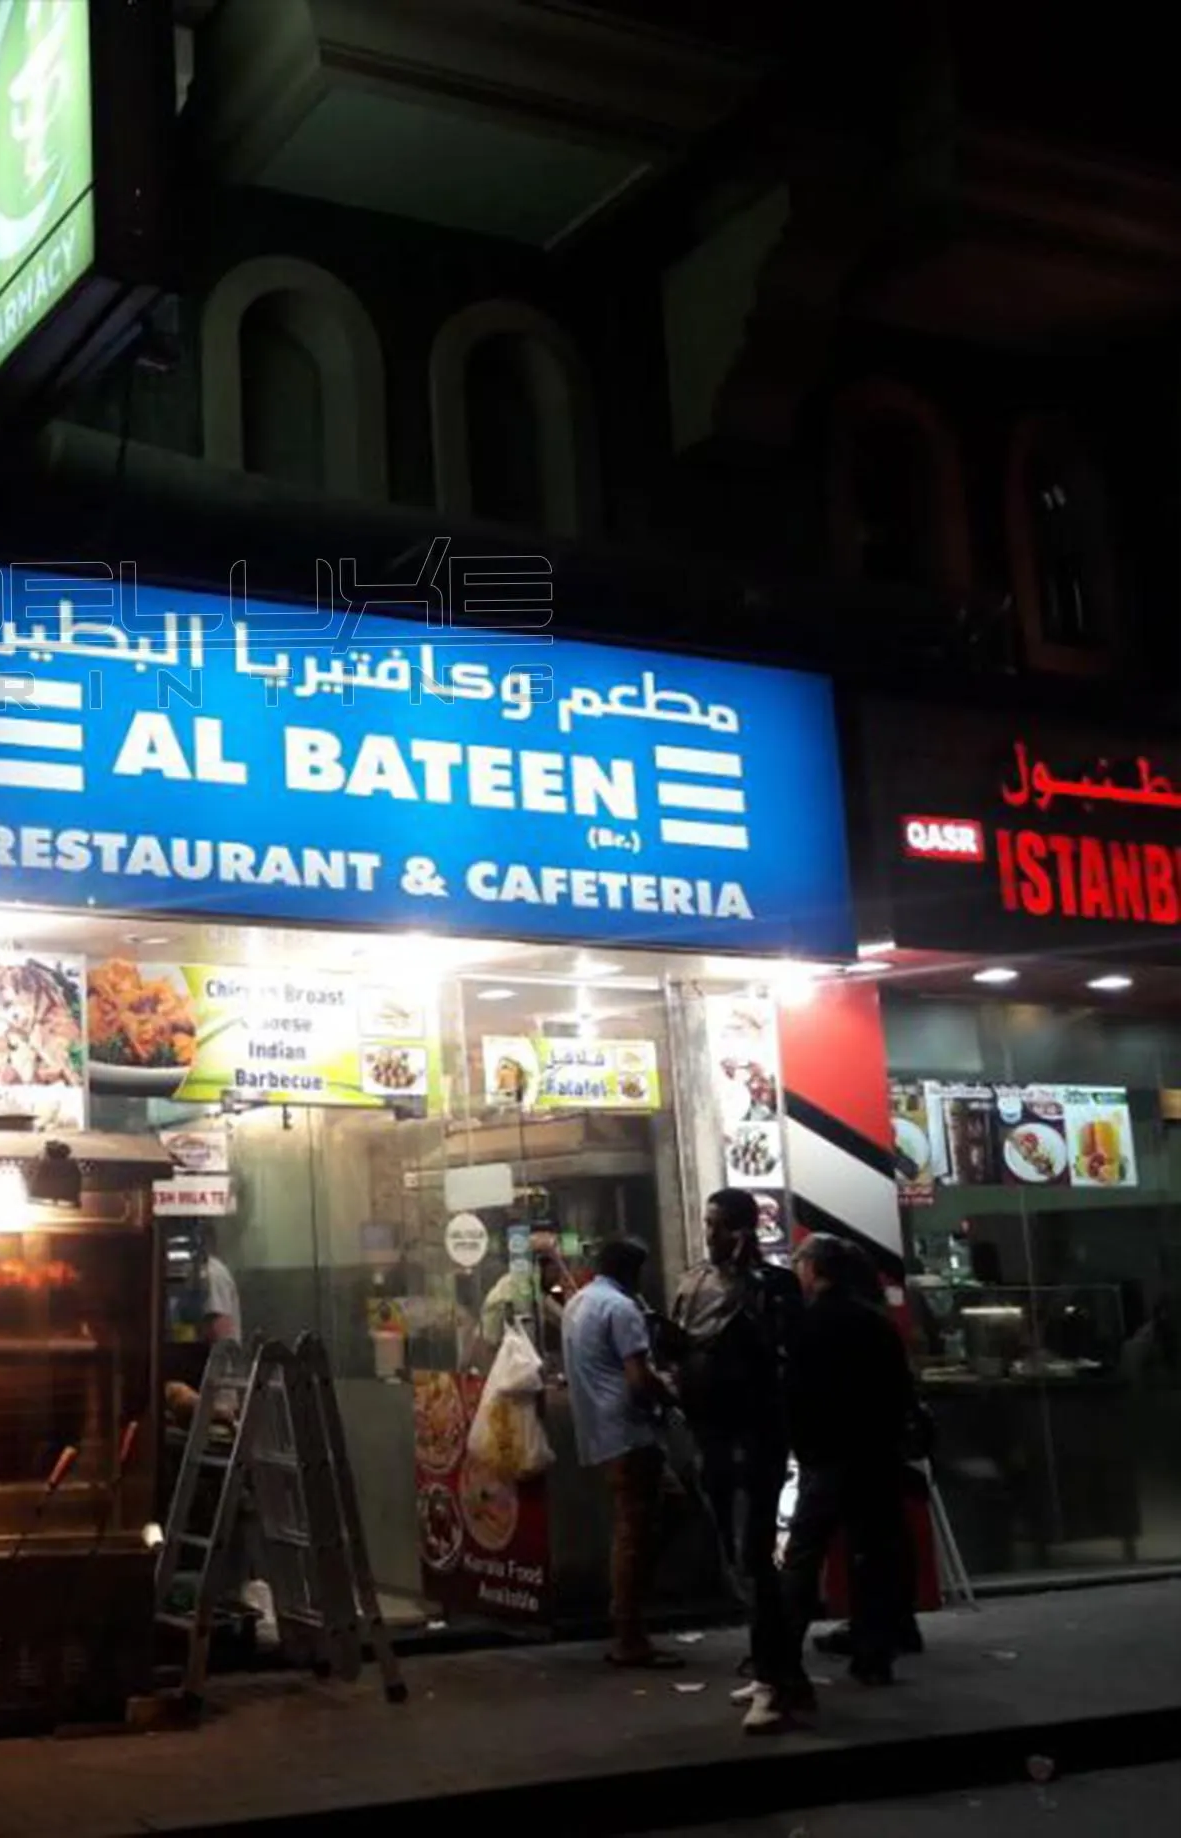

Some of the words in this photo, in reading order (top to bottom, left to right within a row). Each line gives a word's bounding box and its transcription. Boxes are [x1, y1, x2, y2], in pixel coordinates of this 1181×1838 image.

[235, 620, 532, 720] وكافتيريا
[558, 671, 740, 733] مطعم
[112, 711, 247, 785] AL
[283, 726, 639, 820] BATEEN
[906, 821, 978, 854] QASR
[400, 856, 449, 898] &
[465, 861, 755, 921] CAFETERIA
[283, 983, 345, 1006] Broast
[248, 1039, 307, 1060] Indian
[234, 1068, 324, 1092] Barbecue
